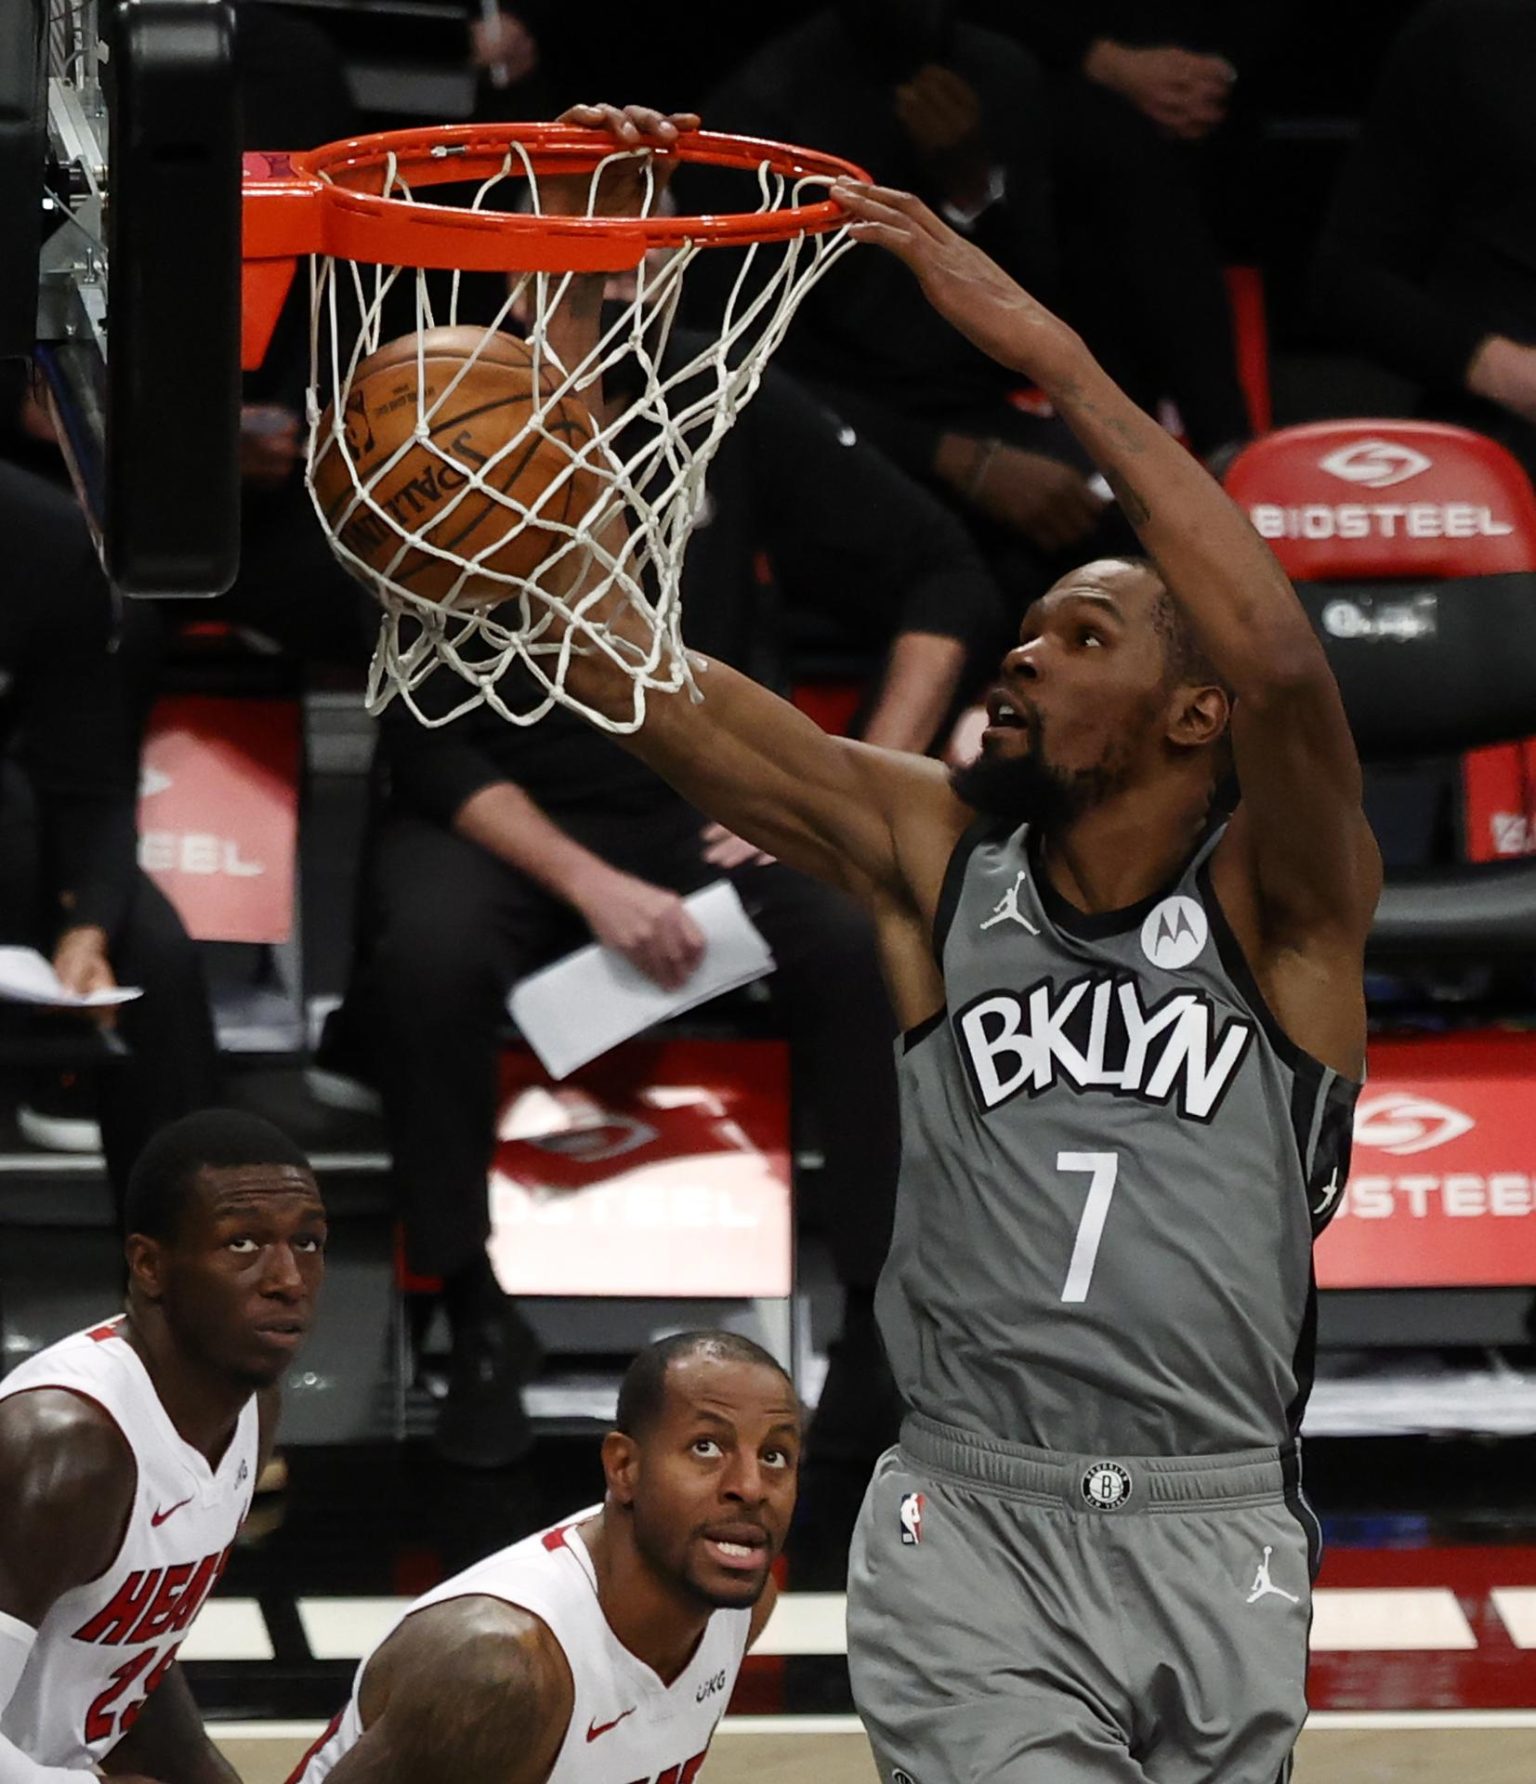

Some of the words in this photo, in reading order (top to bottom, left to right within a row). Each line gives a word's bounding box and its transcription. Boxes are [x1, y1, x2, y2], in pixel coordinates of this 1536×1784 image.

[1252, 503, 1514, 539] BIOSTEEL
[959, 977, 1250, 1120] BKLYN
[1056, 1151, 1119, 1303] 7
[1334, 1172, 1536, 1219] STEE
[71, 1545, 236, 1646] HEA
[695, 1669, 726, 1704] UKG
